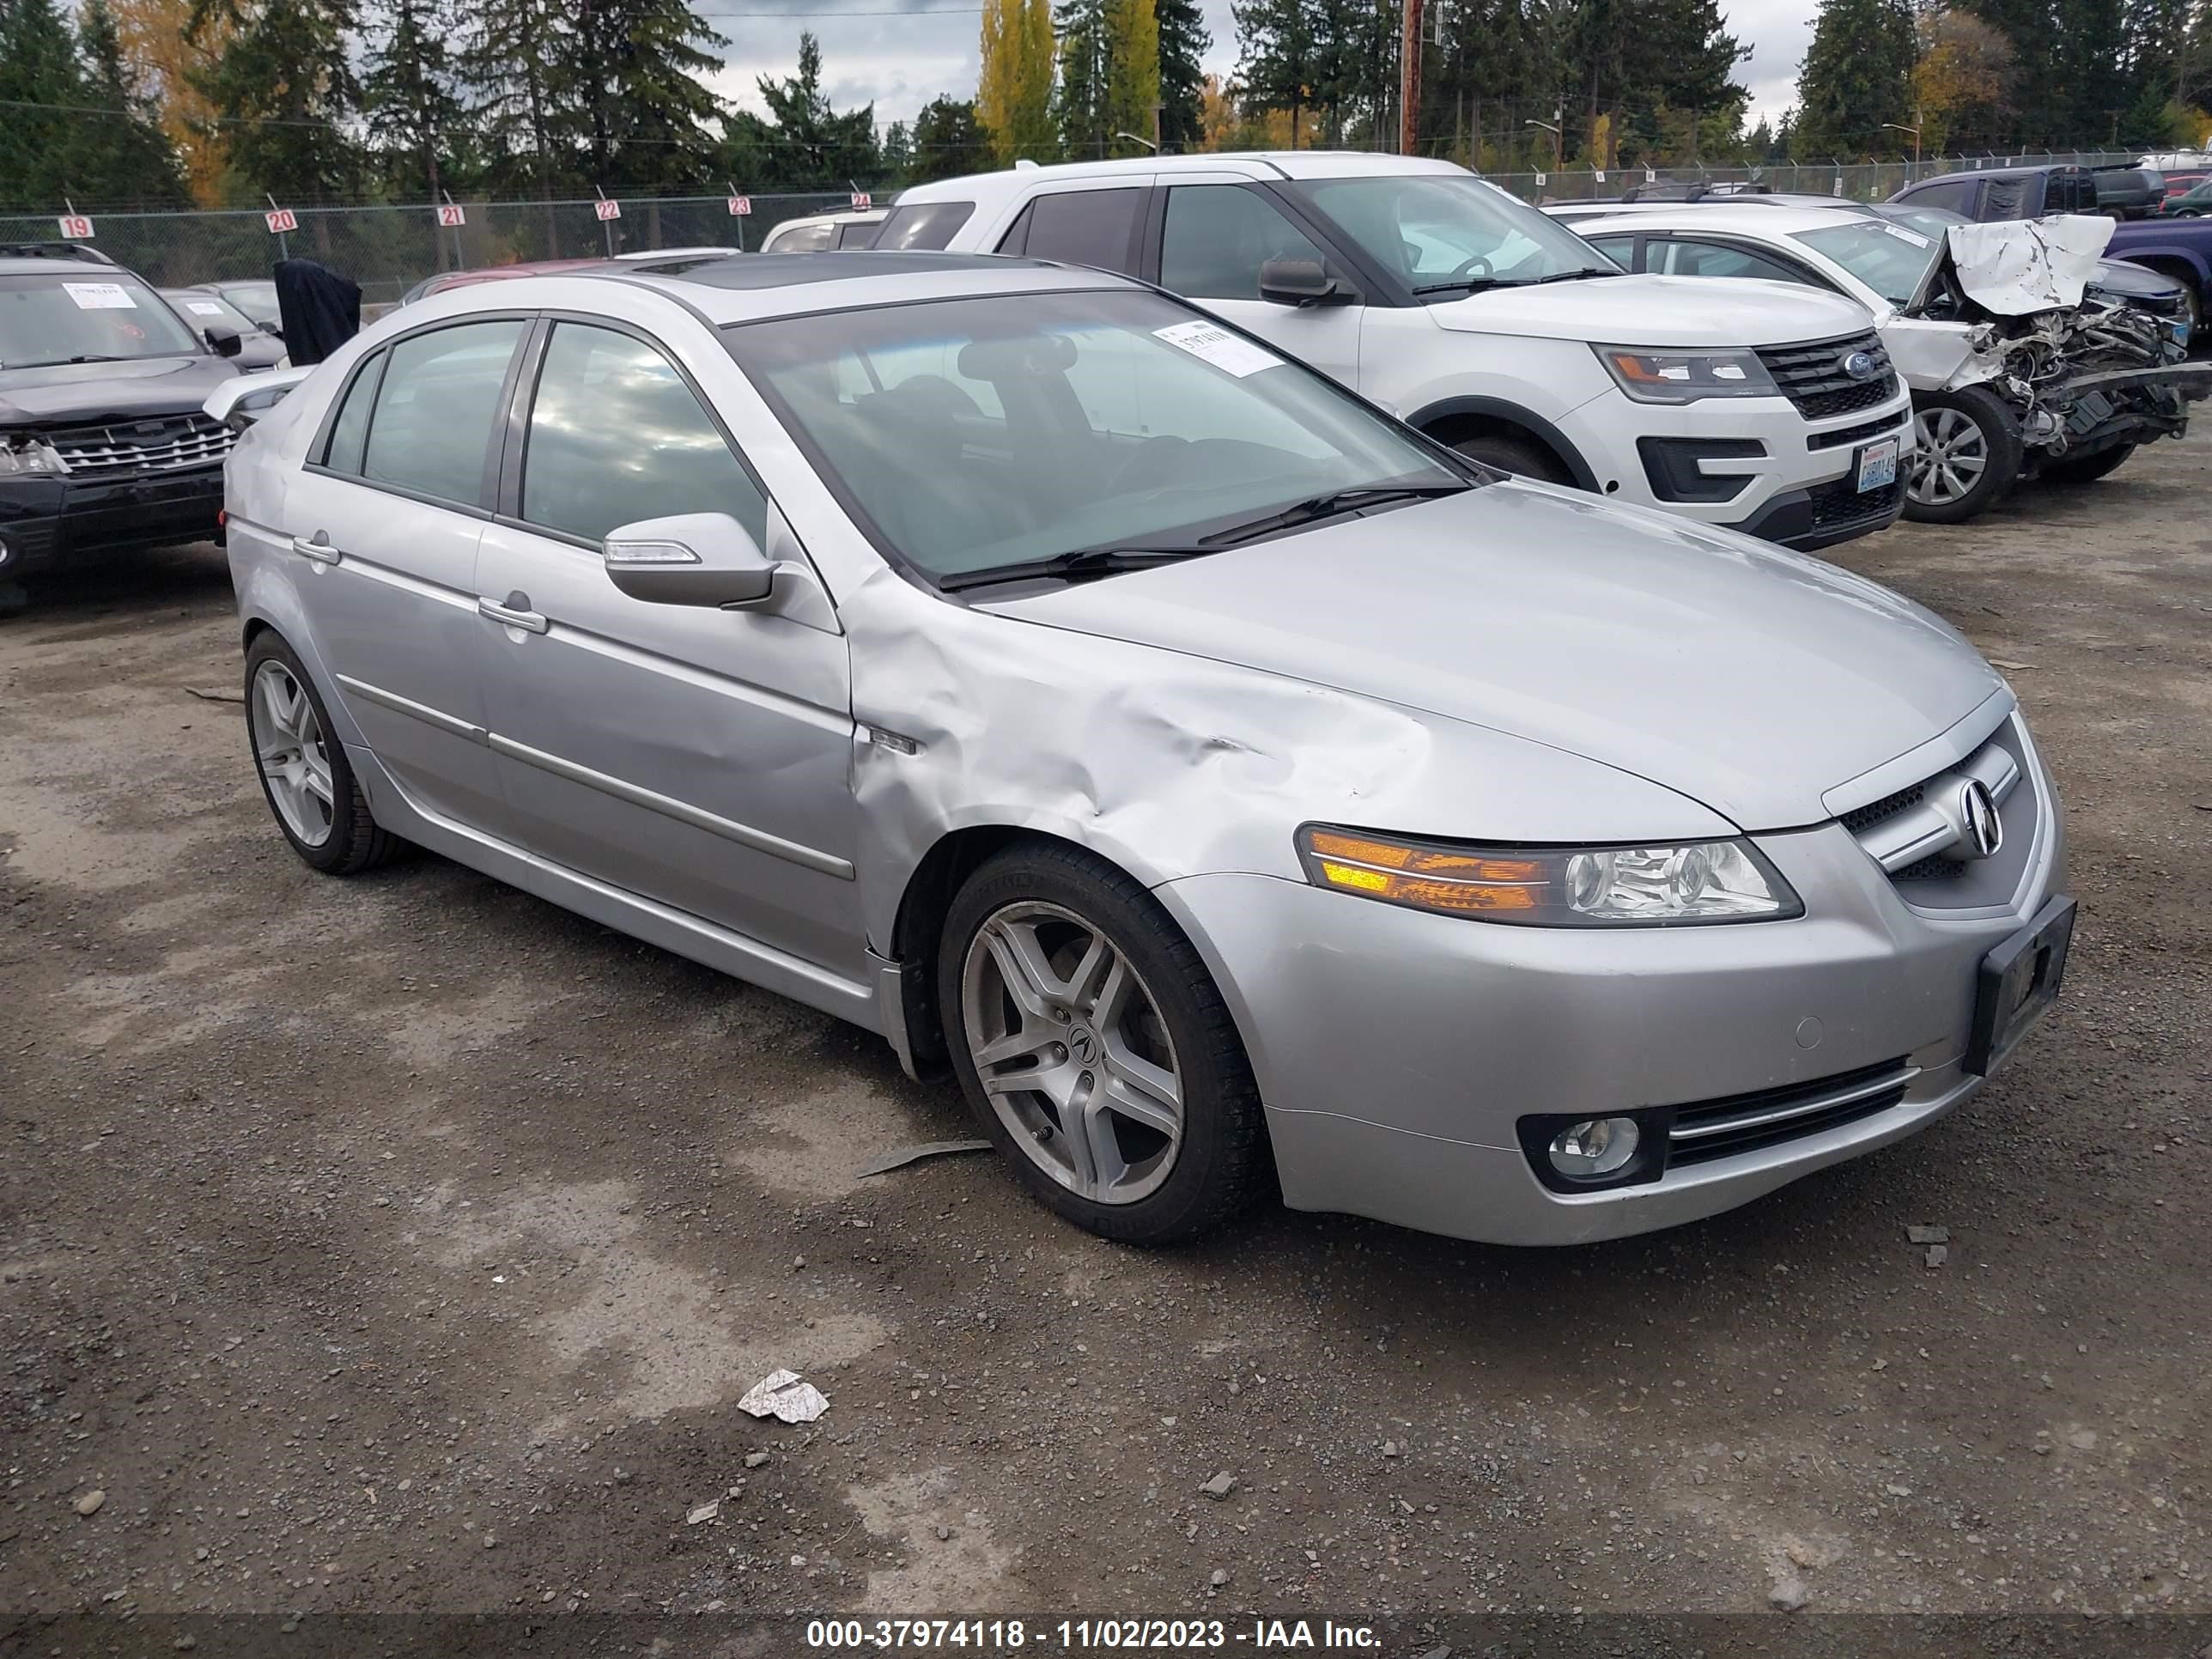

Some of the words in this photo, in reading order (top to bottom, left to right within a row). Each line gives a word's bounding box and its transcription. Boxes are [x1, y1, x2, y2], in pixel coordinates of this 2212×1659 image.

[599, 202, 618, 219] 22
[731, 198, 748, 213] 23
[269, 211, 294, 230] 20
[442, 207, 460, 224] 21
[64, 218, 88, 236] 19
